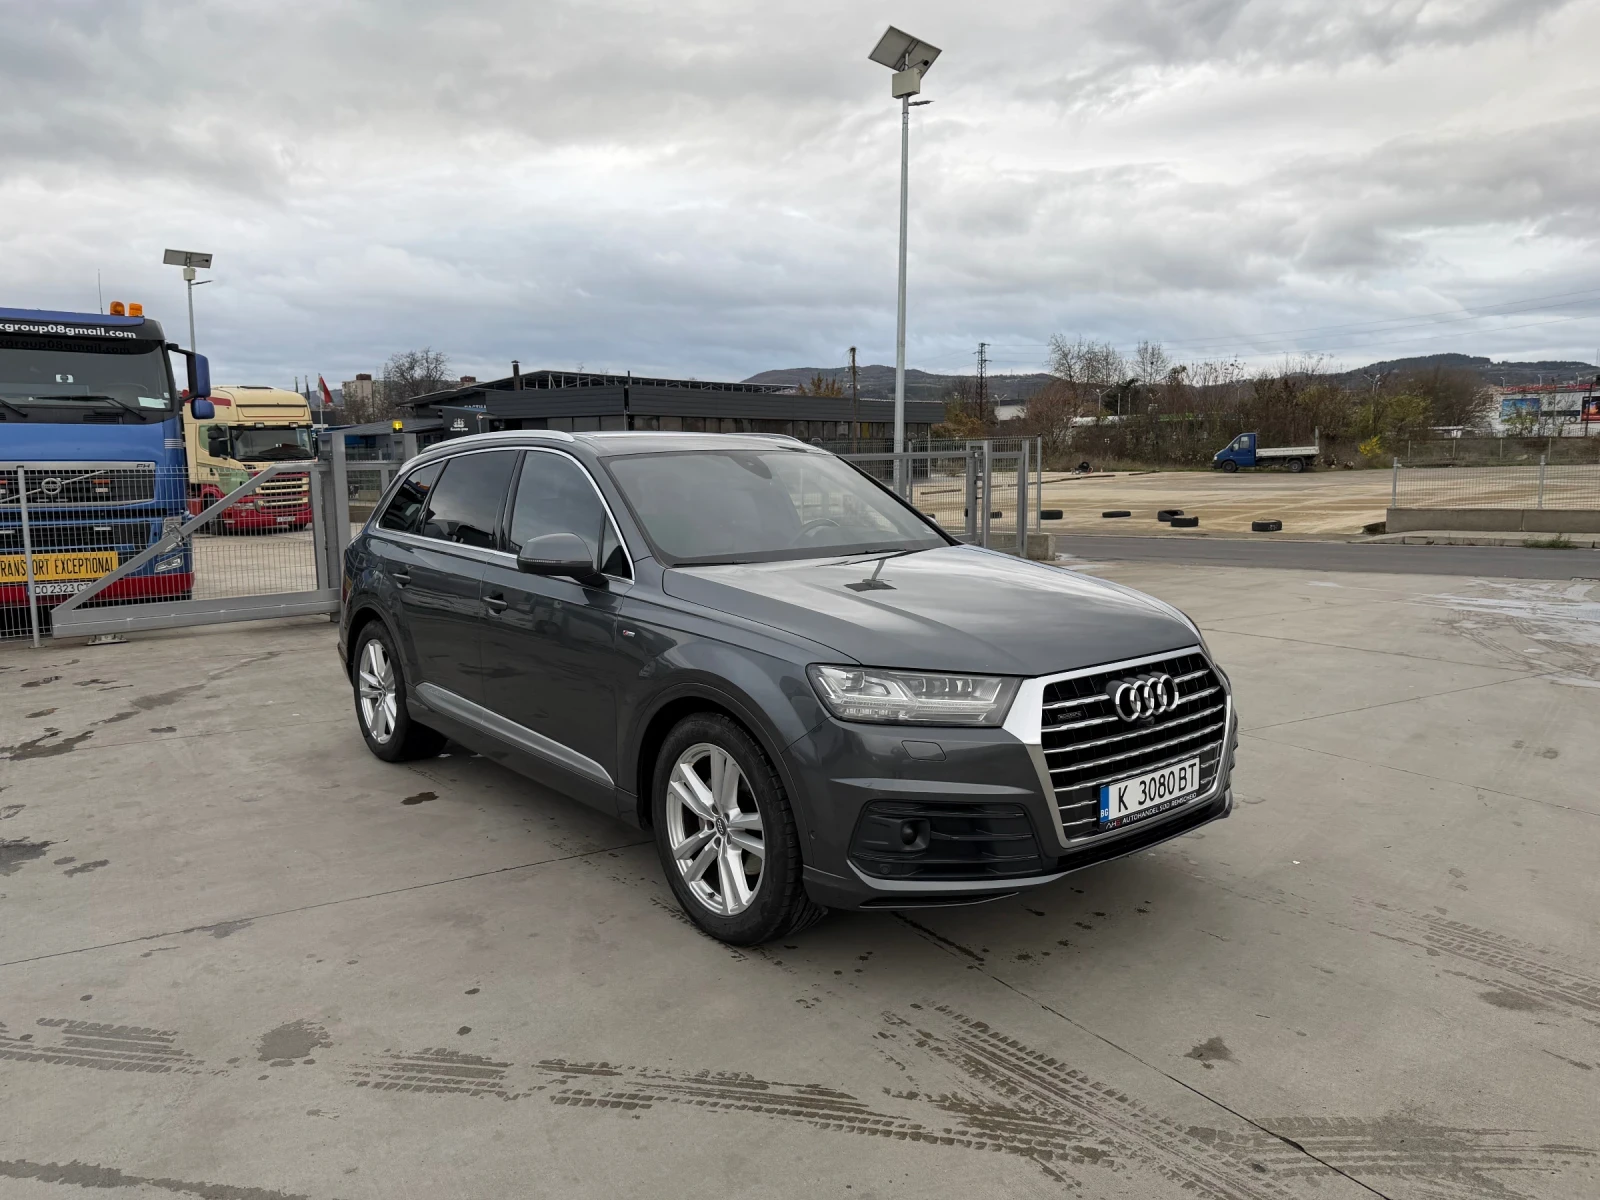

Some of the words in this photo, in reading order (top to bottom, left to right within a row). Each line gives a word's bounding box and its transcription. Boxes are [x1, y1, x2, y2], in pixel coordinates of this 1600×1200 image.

[0, 558, 50, 577] RANSORT
[54, 556, 115, 575] EXCEPTIONAL
[50, 584, 75, 594] 2323
[1118, 785, 1129, 813] K
[1100, 808, 1109, 818] BG
[1122, 807, 1159, 825] AUTOHANDEL
